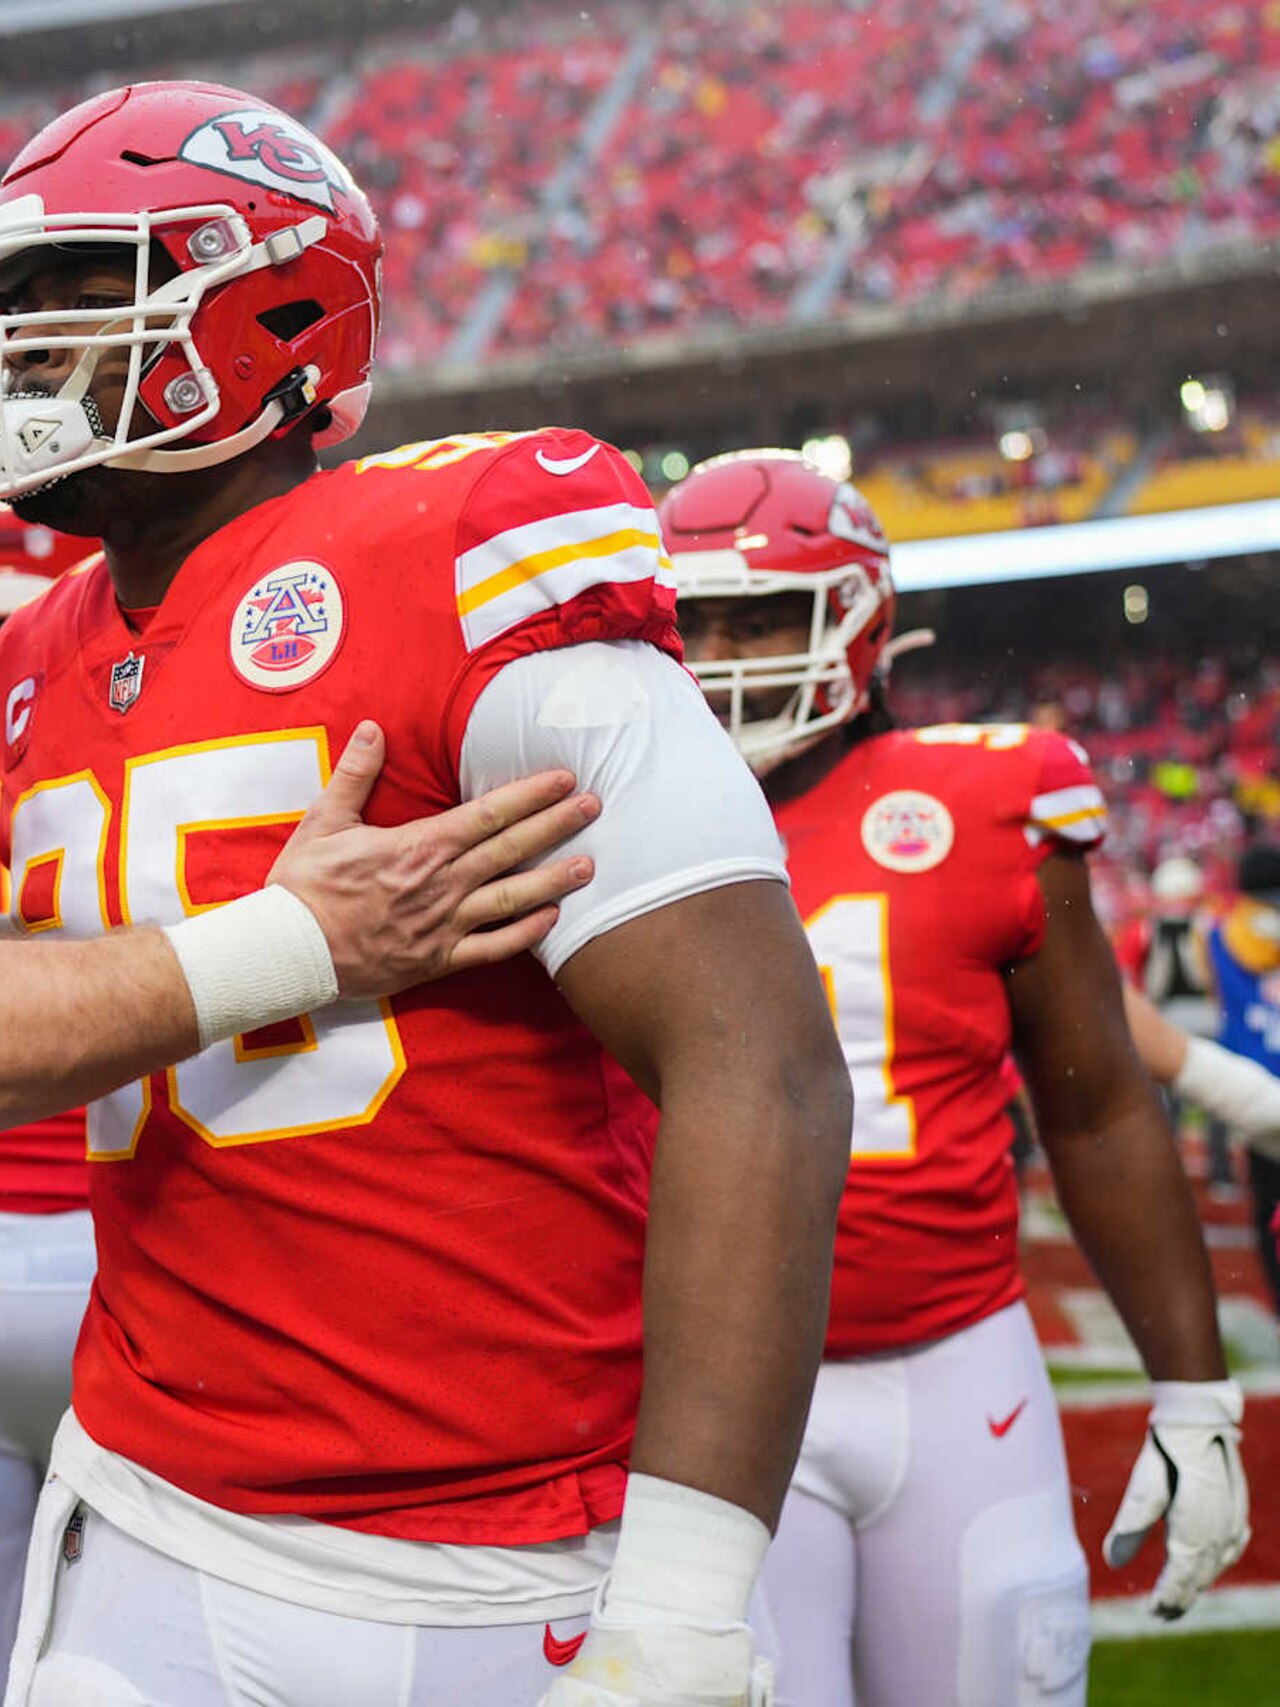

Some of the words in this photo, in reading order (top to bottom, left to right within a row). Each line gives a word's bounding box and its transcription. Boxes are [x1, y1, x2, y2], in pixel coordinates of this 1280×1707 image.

[212, 121, 328, 183] KC
[241, 573, 328, 645] A
[113, 677, 133, 703] NFL
[11, 725, 407, 1162] 95
